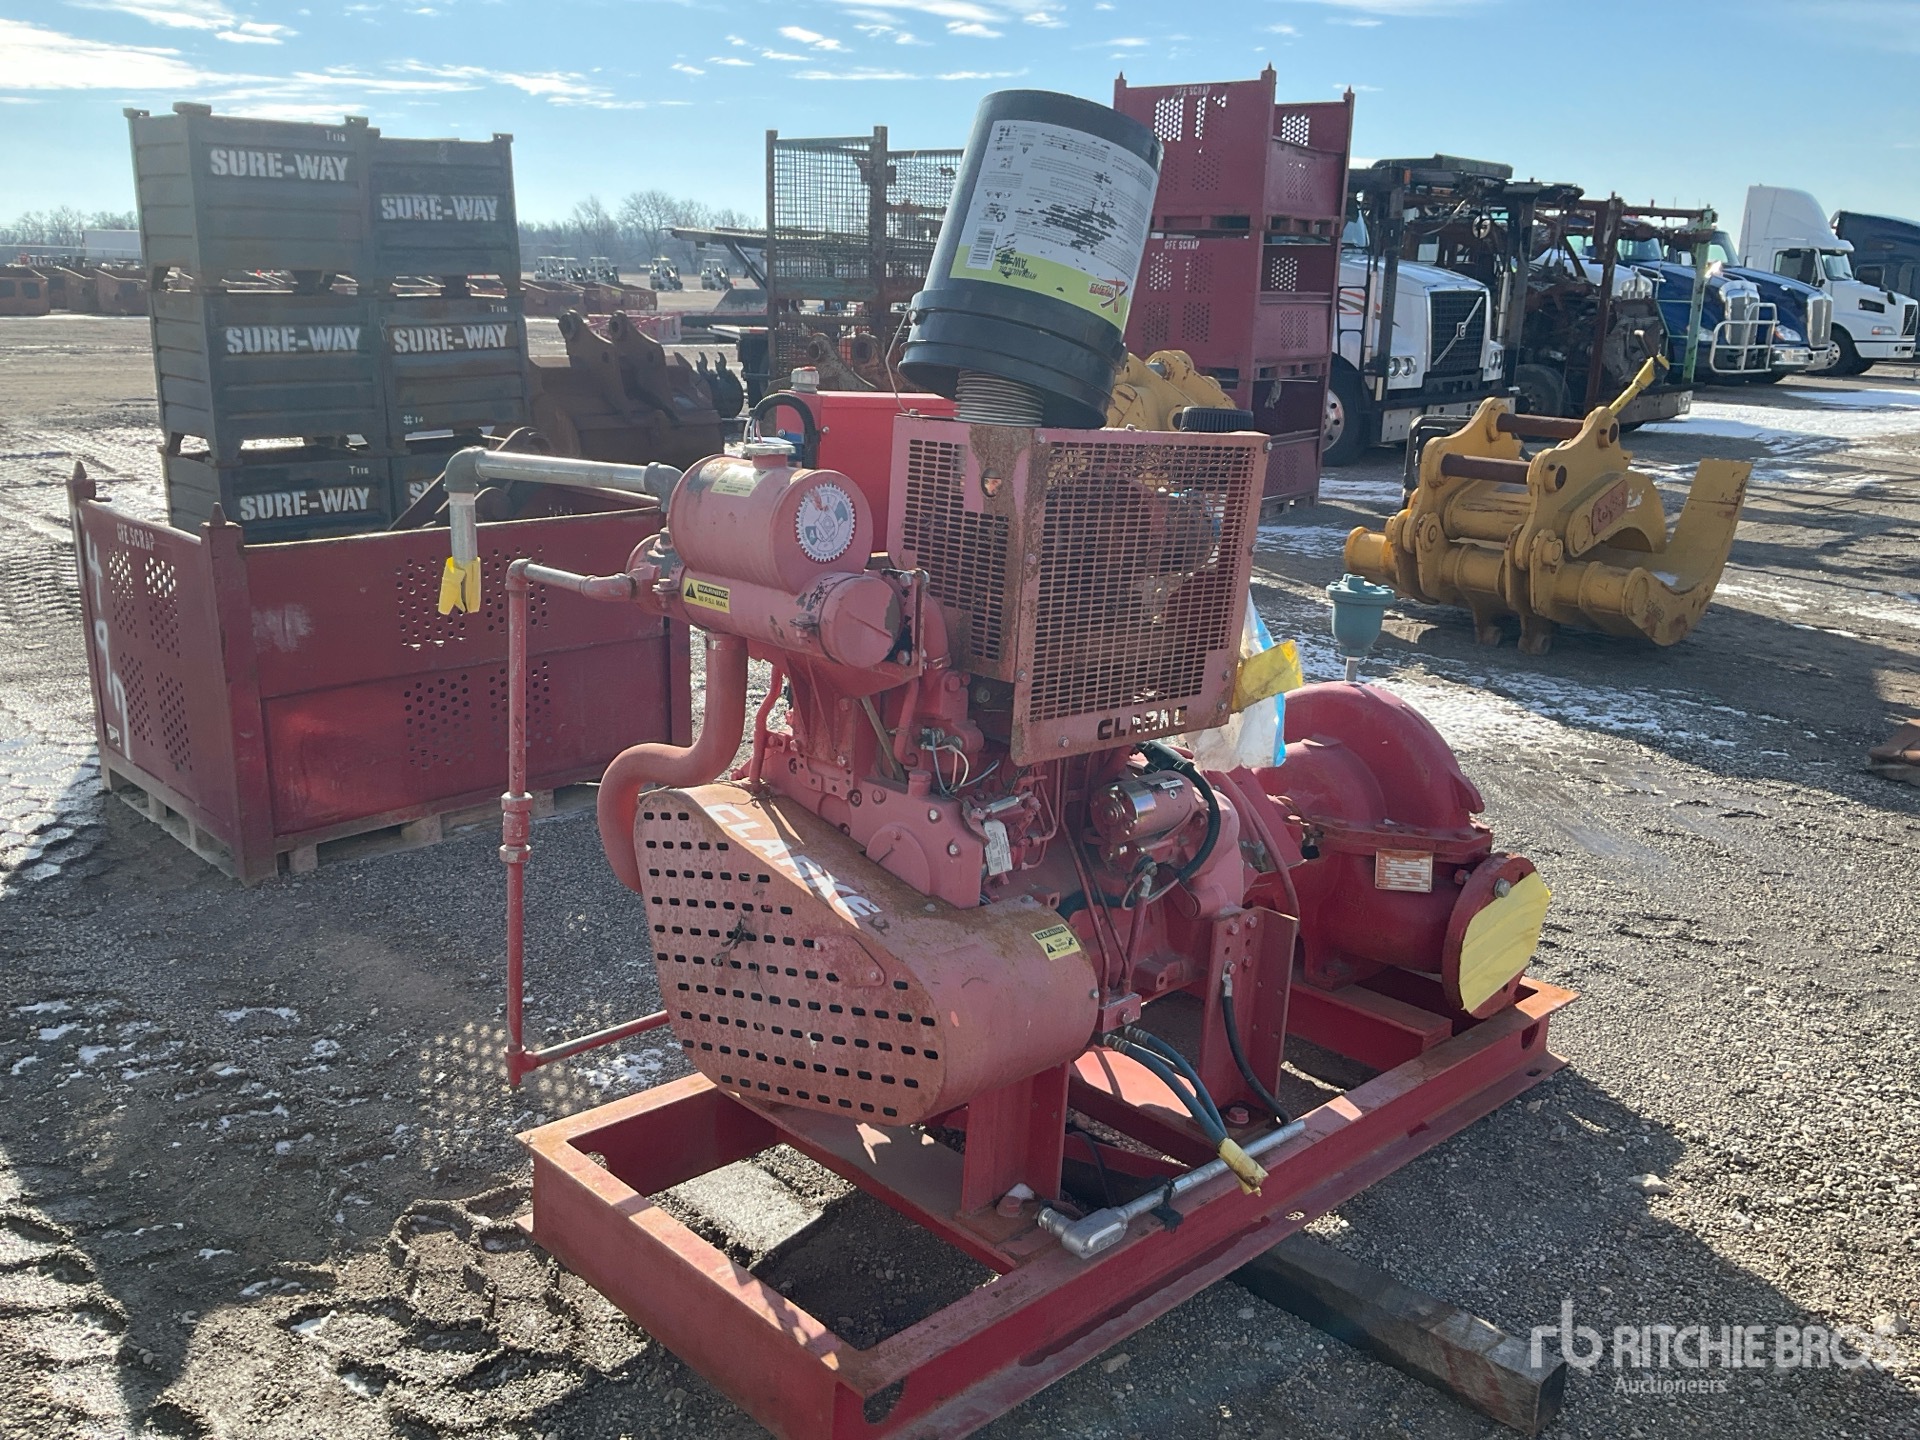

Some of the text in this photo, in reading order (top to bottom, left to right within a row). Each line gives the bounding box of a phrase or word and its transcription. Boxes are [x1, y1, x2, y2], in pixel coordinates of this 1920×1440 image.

[209, 148, 349, 181] SURE-WAY
[381, 193, 499, 222] SURE-WAY
[1178, 240, 1200, 250] SCRAP
[226, 326, 361, 354] SURE-WAY
[393, 324, 508, 353] SURE-WAY
[239, 487, 370, 521] SURE-WAY
[116, 522, 155, 551] GFE SCRAP
[697, 583, 729, 600] WARNING
[704, 803, 884, 919] CLARKE
